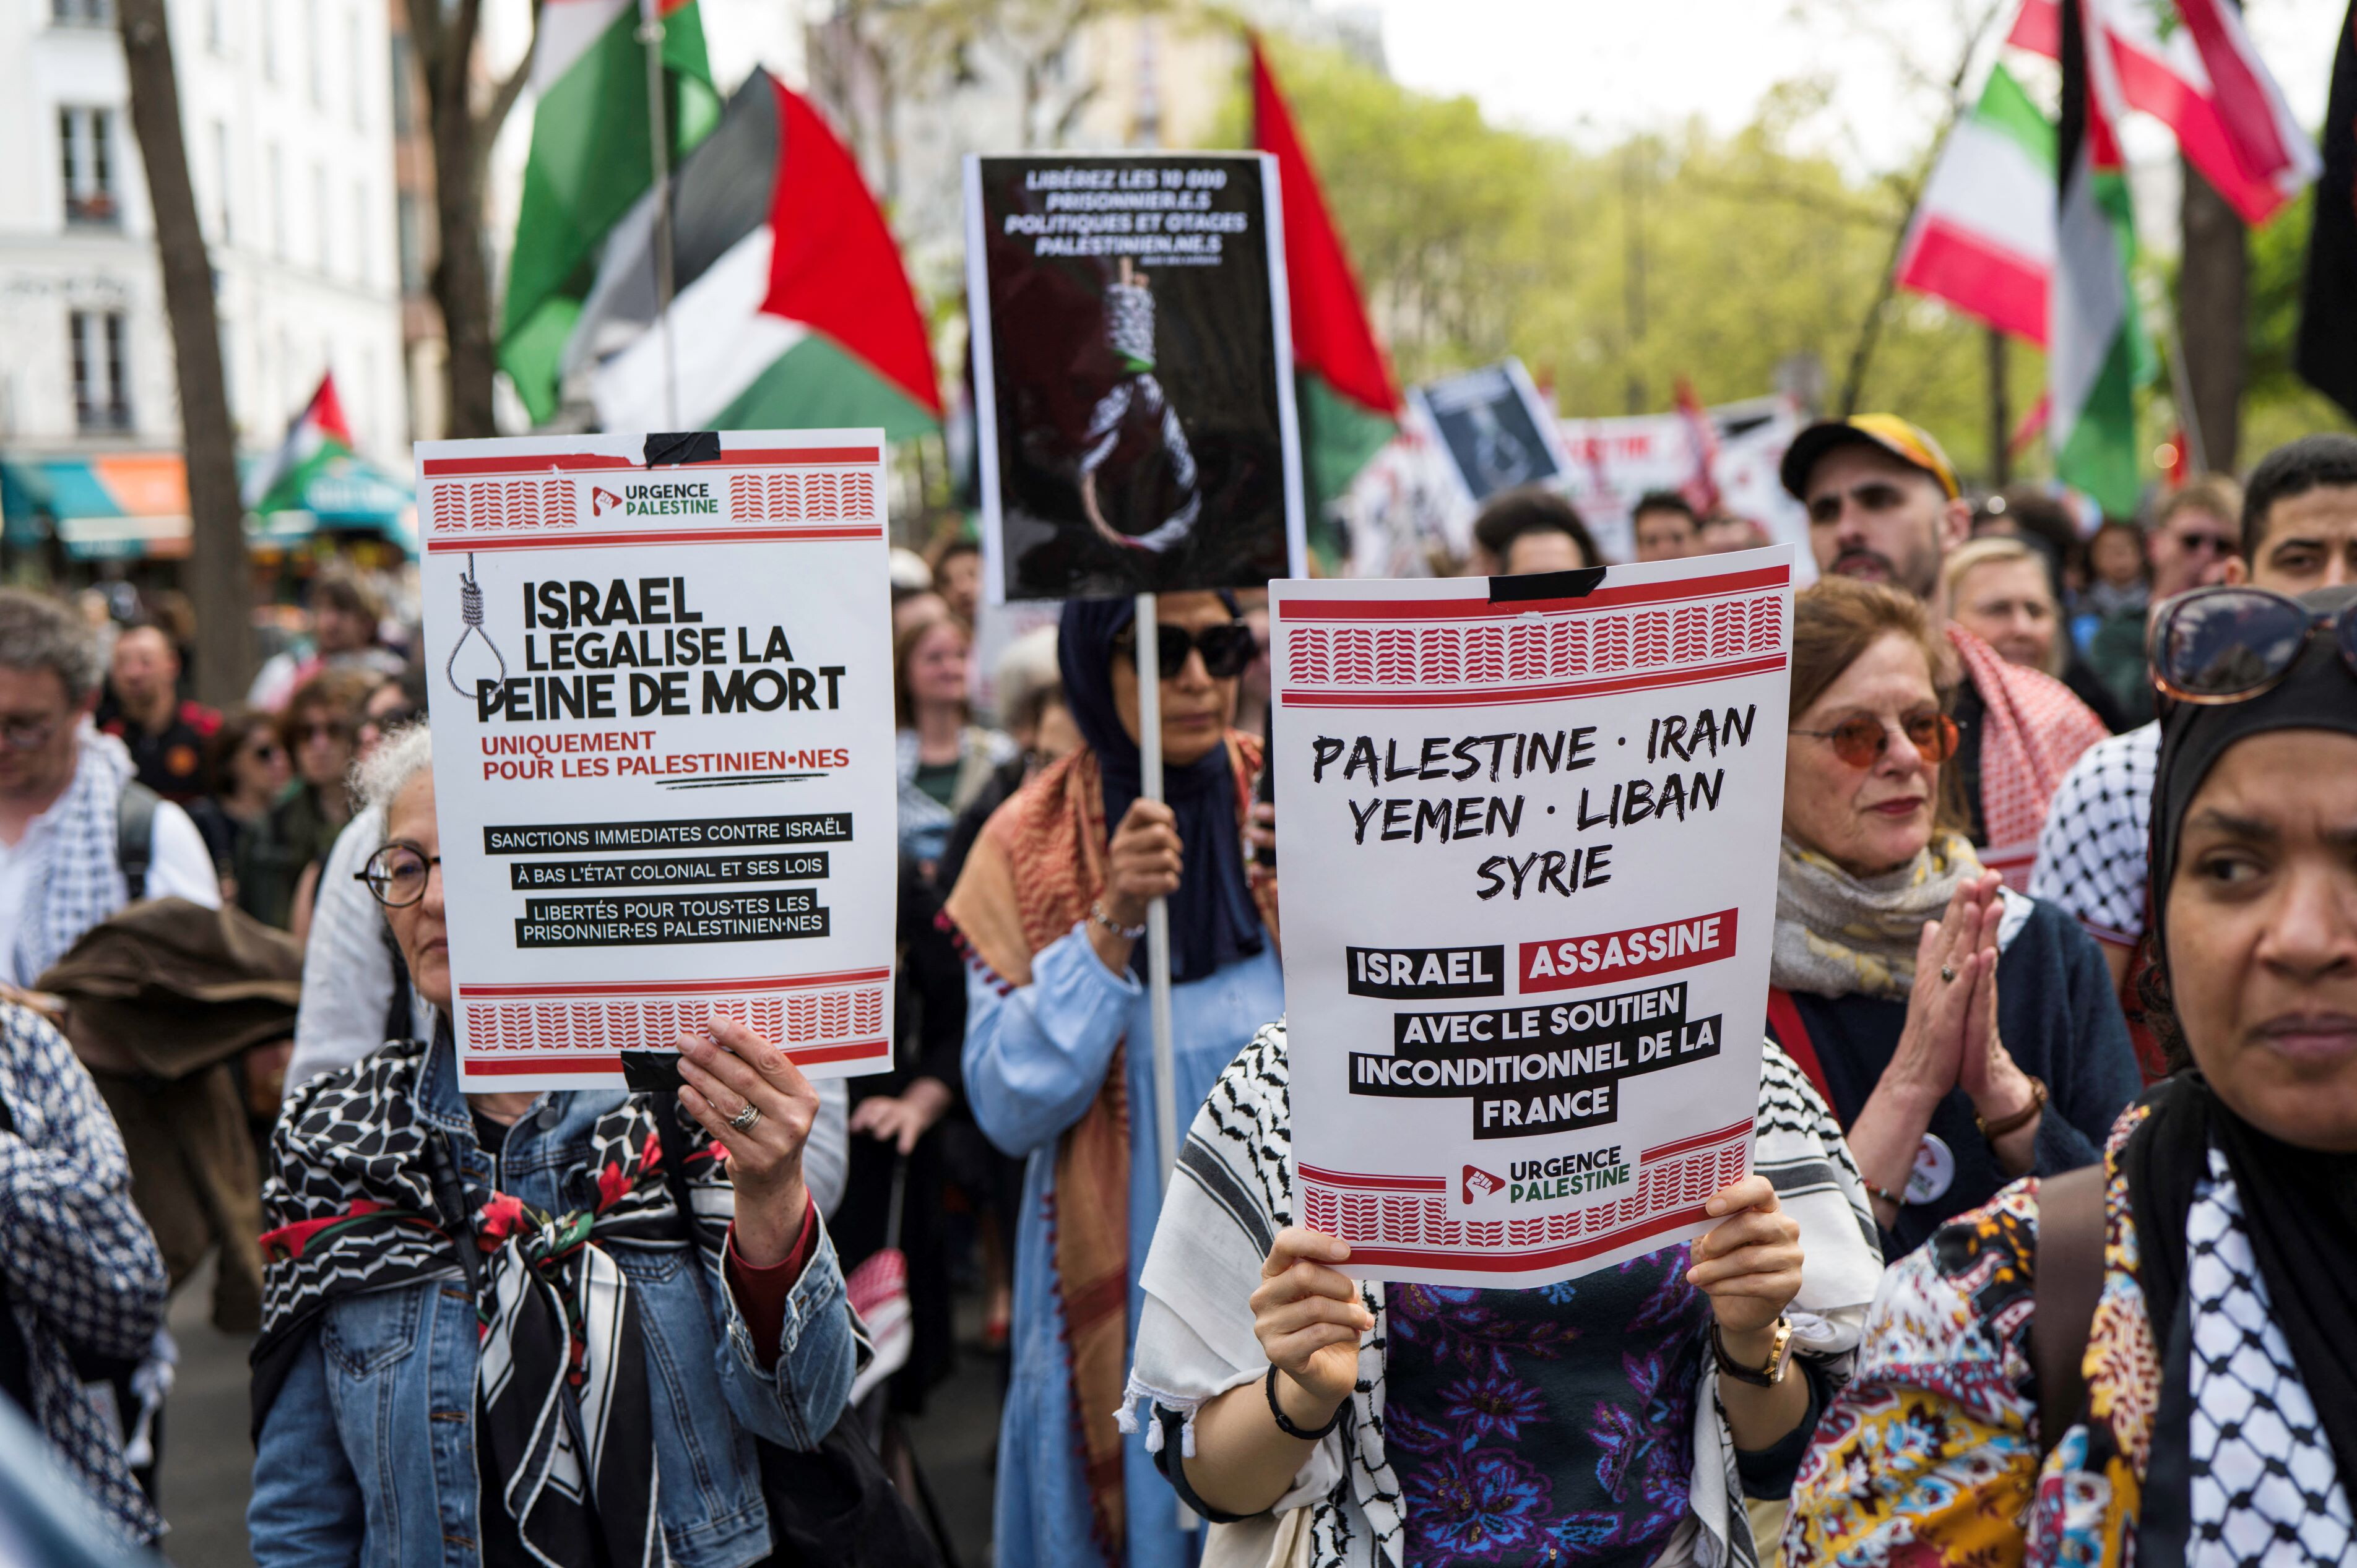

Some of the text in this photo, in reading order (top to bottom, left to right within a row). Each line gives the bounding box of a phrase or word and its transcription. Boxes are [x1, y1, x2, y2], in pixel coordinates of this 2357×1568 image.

[1026, 166, 1115, 189] LIBÉREZ
[1118, 169, 1158, 190] LES
[1005, 212, 1247, 235] POLITIQUES ET OTAGES
[626, 484, 709, 499] URGENCE
[626, 499, 718, 515] PALESTINE
[524, 577, 703, 628] ISRAEL
[525, 623, 794, 671] LÉGALISE LA
[477, 666, 845, 722] PEINE DE MORT
[482, 731, 655, 758] UNIQUEMENT
[1313, 726, 1597, 788] PALESTINE
[1648, 704, 1757, 764] IRAN
[484, 760, 553, 780] POUR
[562, 758, 609, 777] LES
[1349, 795, 1524, 845] YEMEN
[1577, 769, 1724, 831] LIBAN
[492, 817, 845, 848] SANCTIONS IMMEDIATES CONTRE ISRAËL
[518, 858, 822, 882] À BAS L’ÉTAT COLONIAL ET SES LOIS
[1477, 845, 1612, 900] SYRIE
[535, 900, 618, 921] LIBERTÉS
[625, 902, 674, 918] POUR
[776, 896, 810, 912] LES
[1357, 916, 1720, 985] ISRAEL ASSASSINE
[1403, 987, 1679, 1043] AVEC LE SOUTIEN
[1358, 1021, 1714, 1085] INCONDITIONNEL DE LA
[1484, 1086, 1609, 1127] FRANCE
[1511, 1145, 1620, 1181] URGENCE
[1511, 1163, 1630, 1203] PALESTINE
